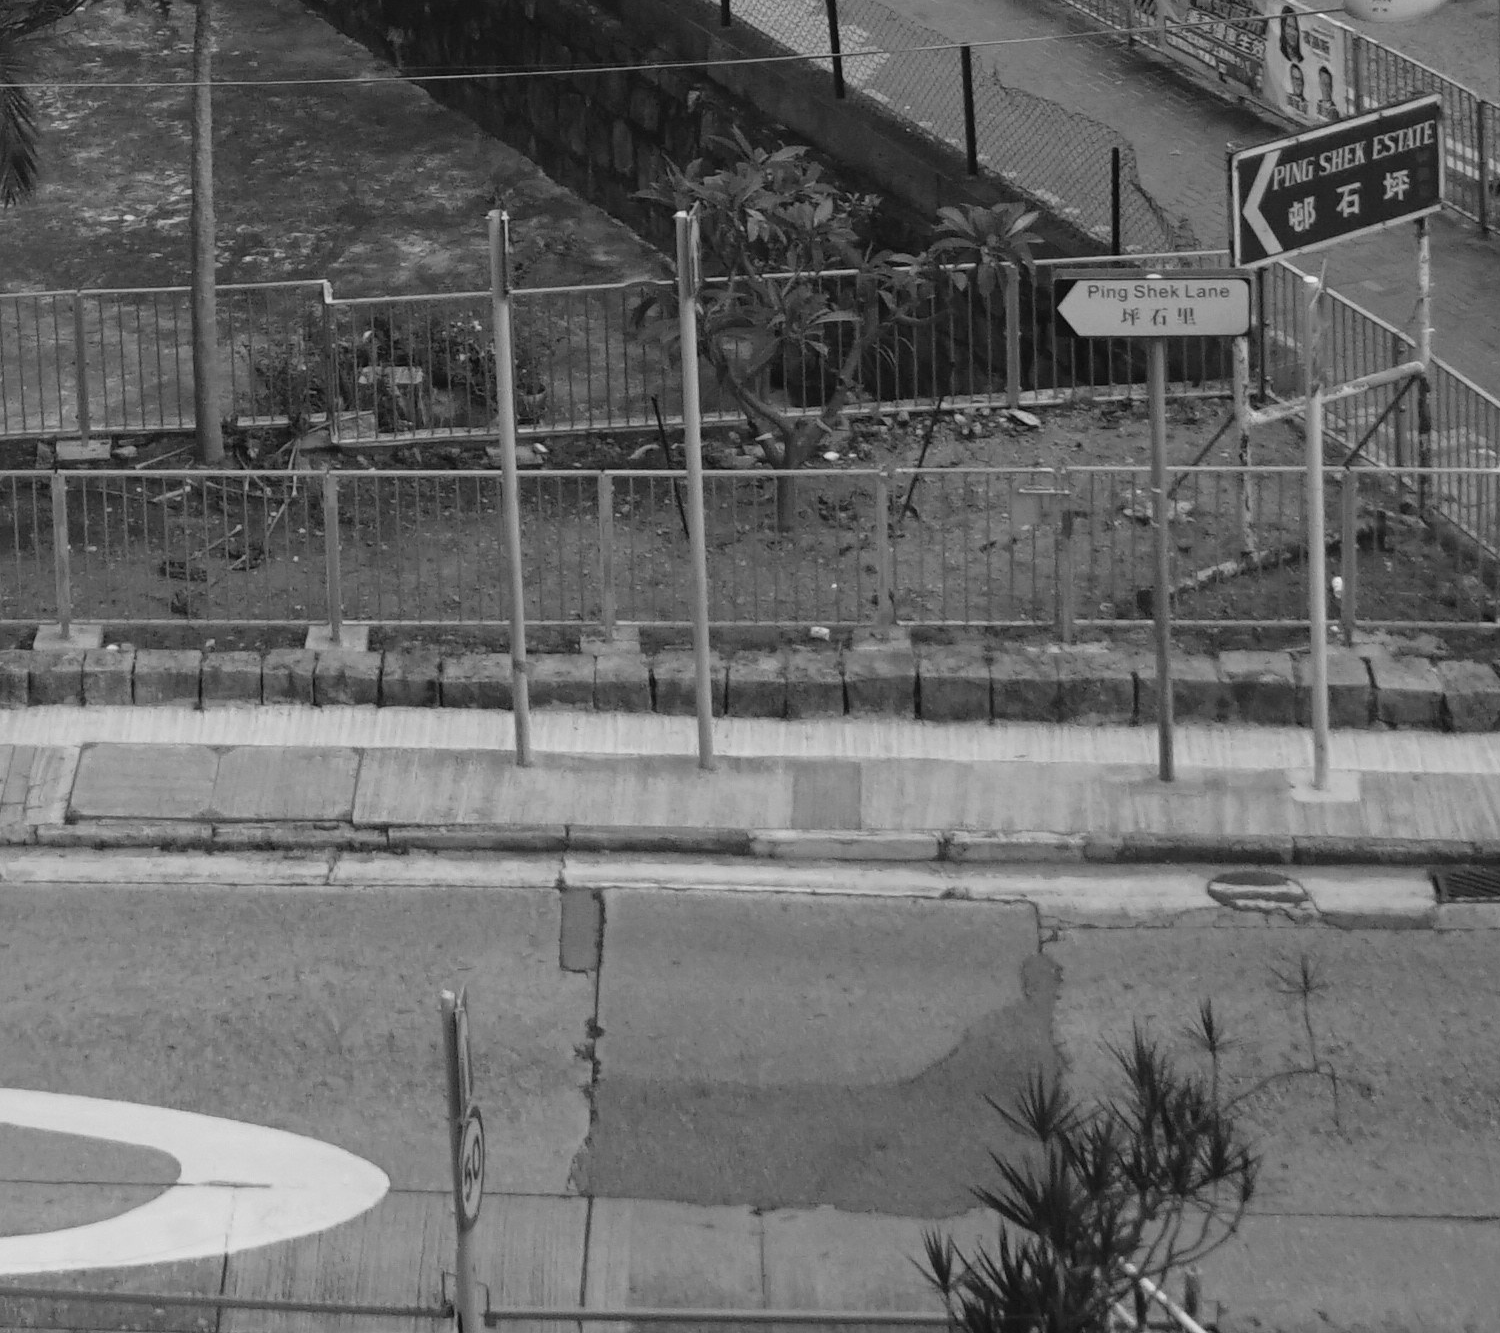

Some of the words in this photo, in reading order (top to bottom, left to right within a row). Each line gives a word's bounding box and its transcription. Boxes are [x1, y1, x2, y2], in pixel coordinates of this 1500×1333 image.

[1272, 156, 1316, 191] PING
[1318, 140, 1367, 176] SHEK
[1371, 119, 1436, 160] ESTATE
[1087, 284, 1128, 302] Ping
[1133, 284, 1180, 299] Shek
[1185, 284, 1230, 299] Lane
[1120, 307, 1197, 326] 坪石里
